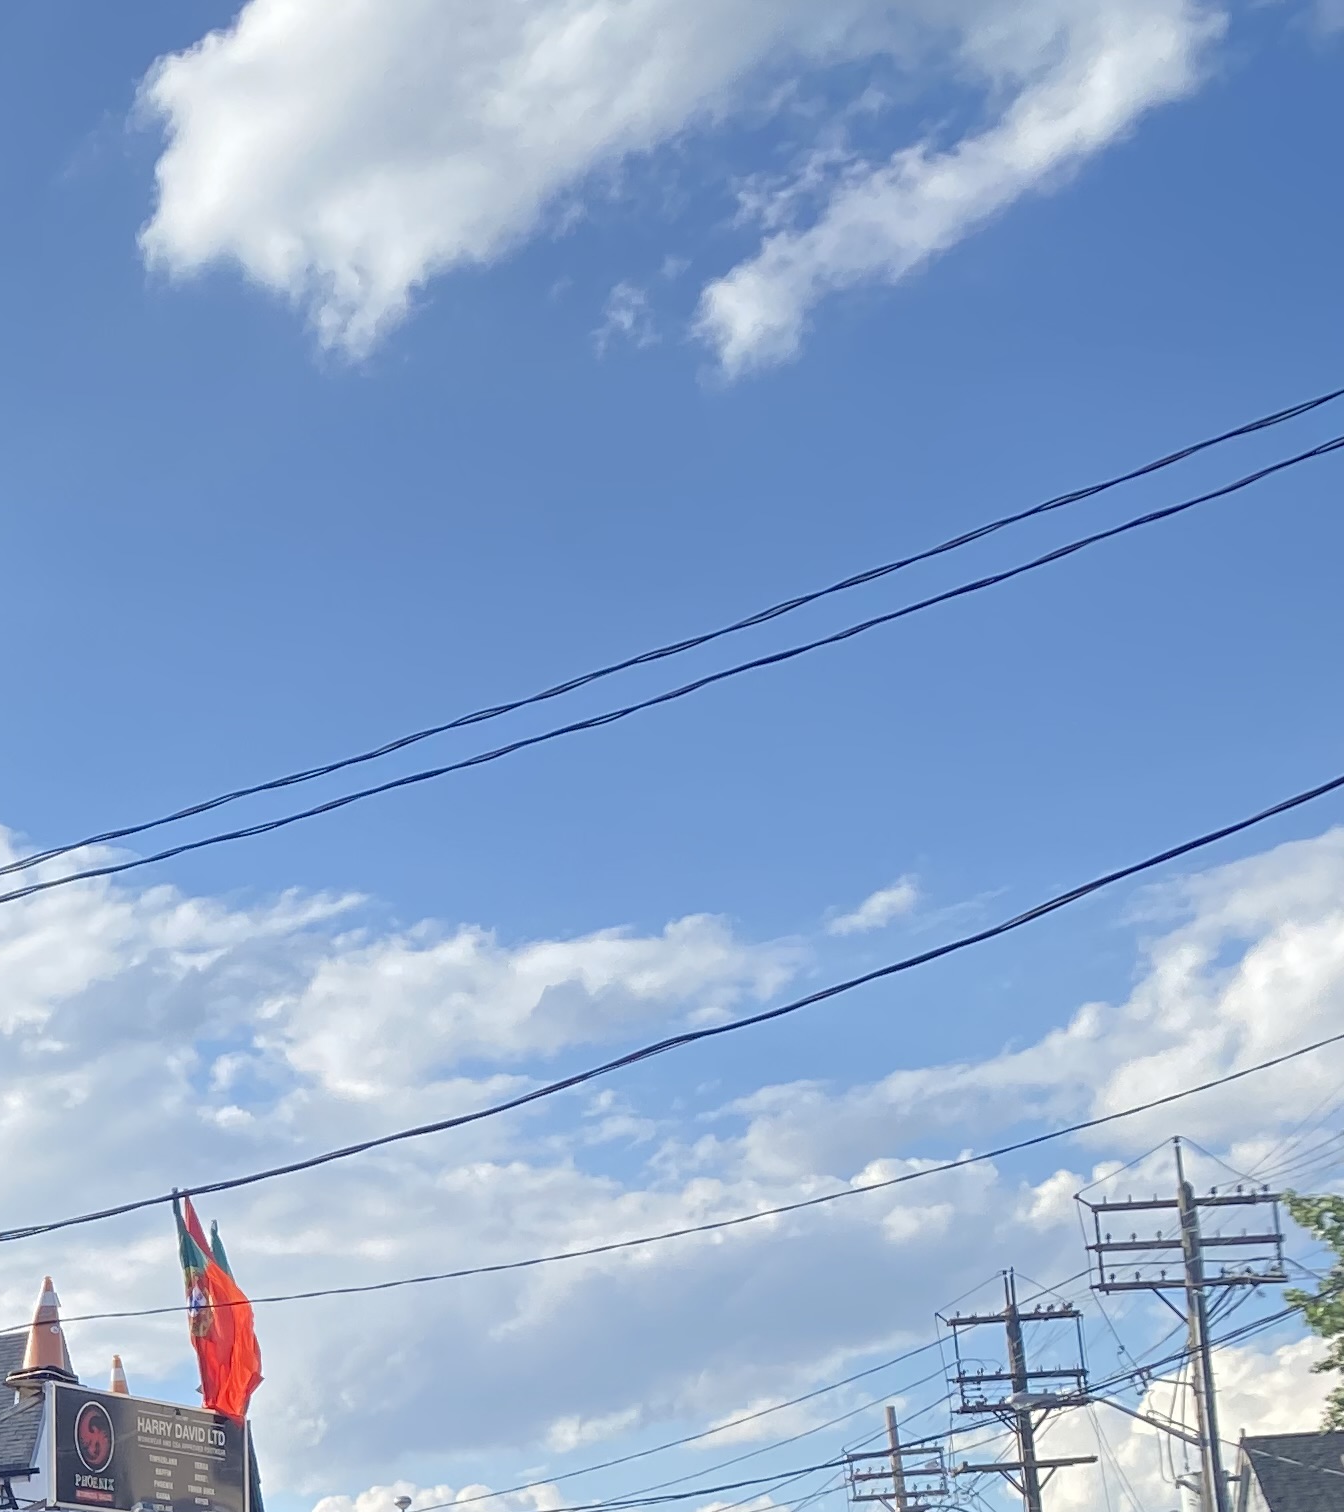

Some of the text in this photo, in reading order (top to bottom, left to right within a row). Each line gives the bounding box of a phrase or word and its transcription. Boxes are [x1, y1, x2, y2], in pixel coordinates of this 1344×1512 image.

[137, 1416, 226, 1447] HARRY DAVID LTD
[75, 1473, 115, 1492] PHOENIX
